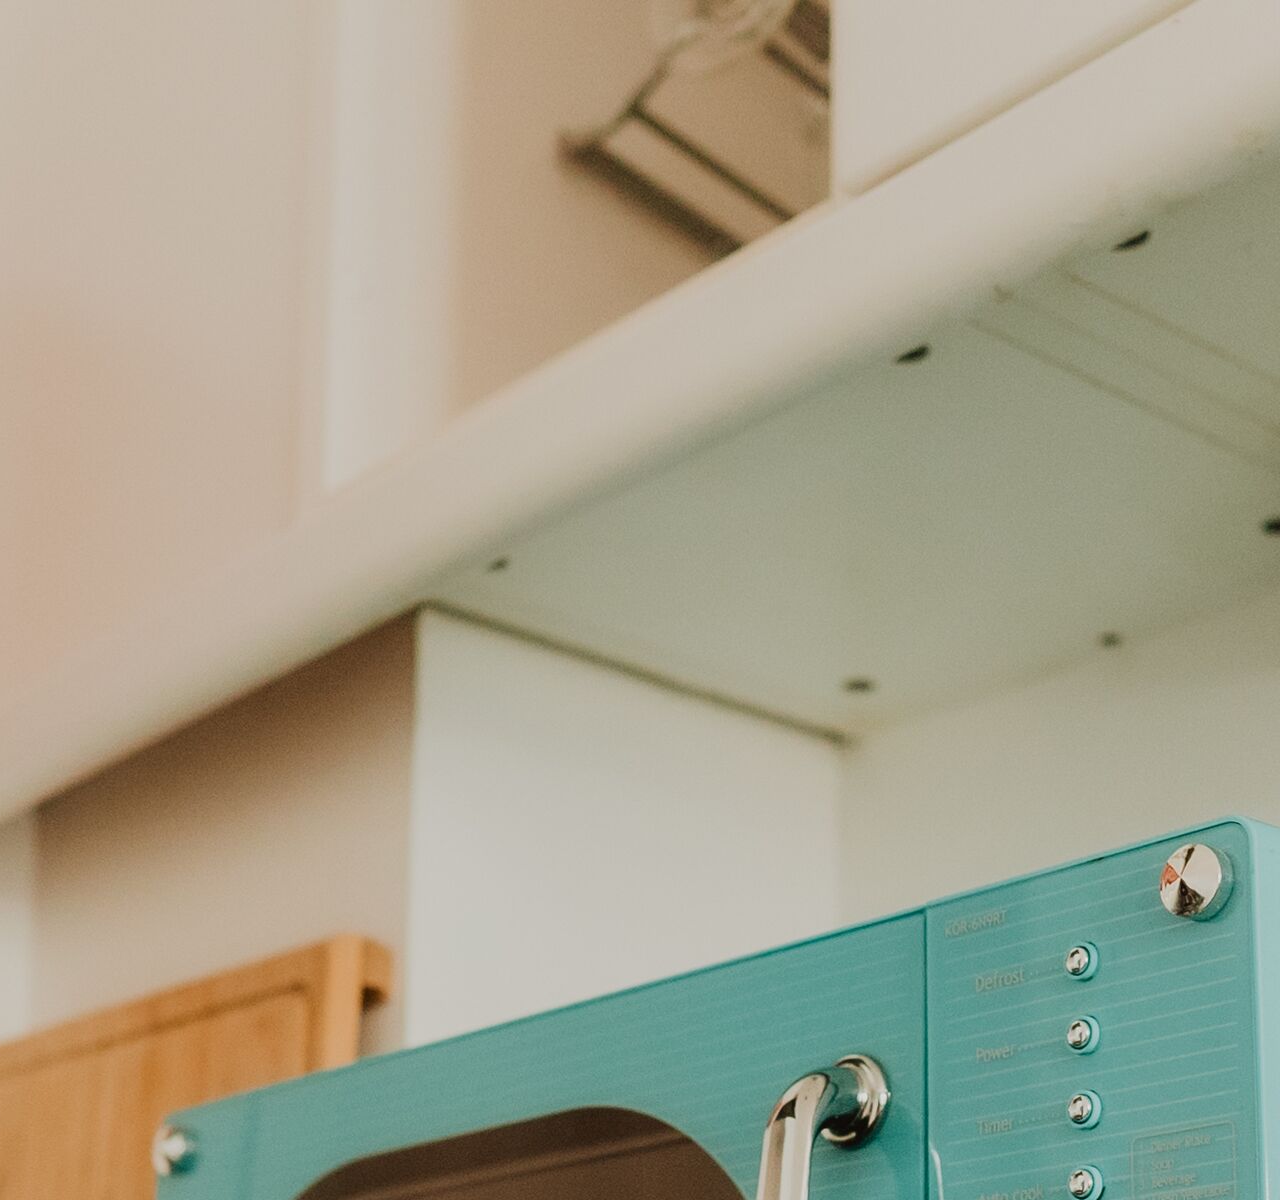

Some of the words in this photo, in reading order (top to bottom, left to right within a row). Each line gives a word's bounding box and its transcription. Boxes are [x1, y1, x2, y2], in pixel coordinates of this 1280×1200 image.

[975, 965, 1025, 993] Defrost
[975, 1043, 1016, 1064] Power
[976, 1117, 1014, 1136] Timer
